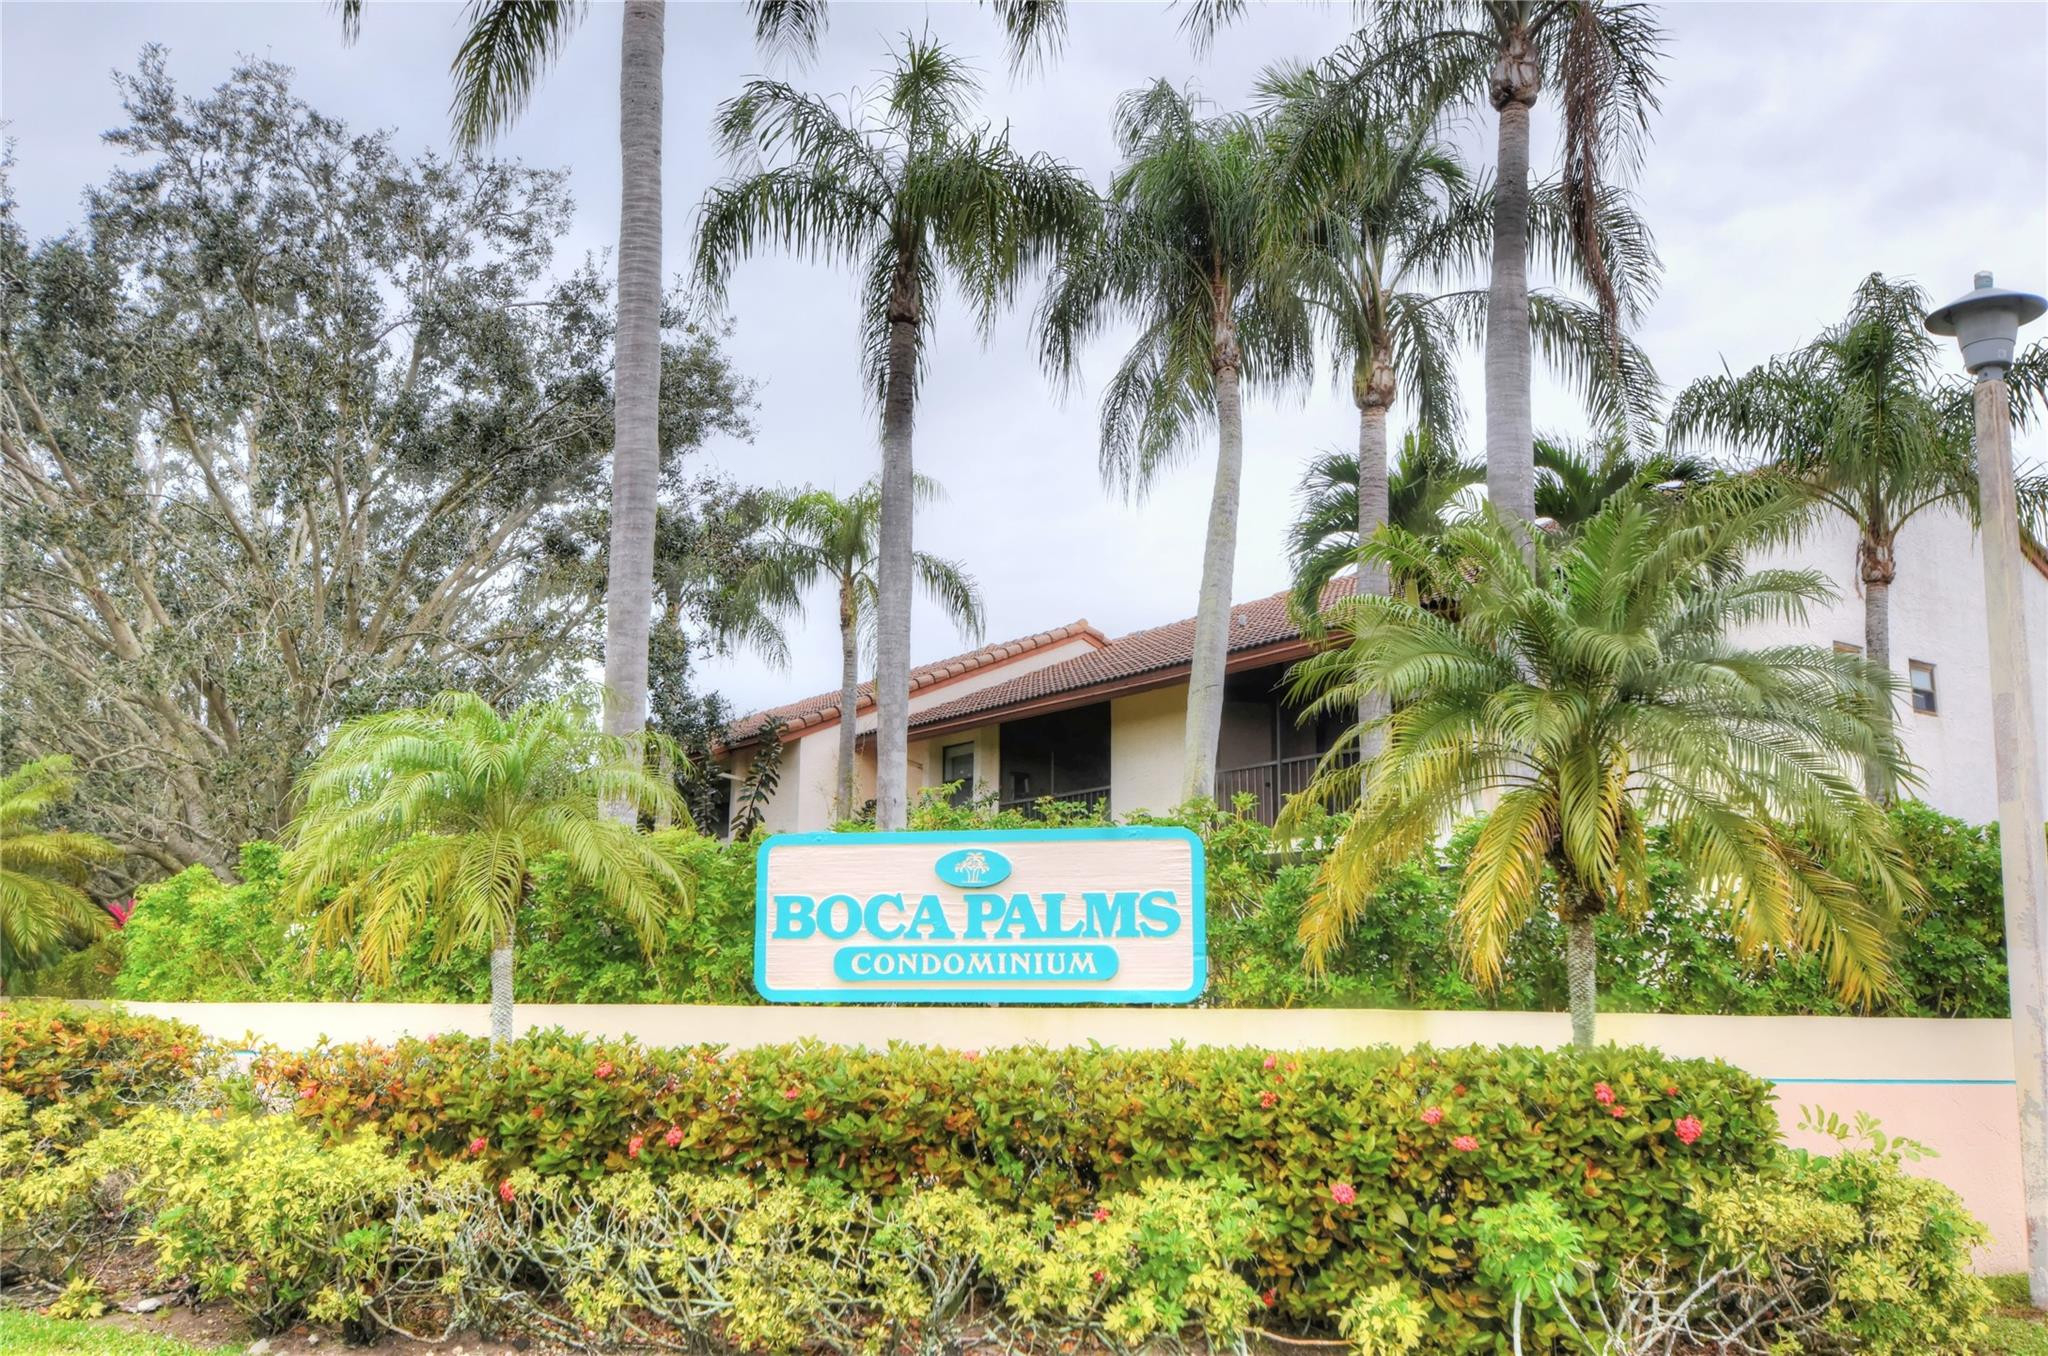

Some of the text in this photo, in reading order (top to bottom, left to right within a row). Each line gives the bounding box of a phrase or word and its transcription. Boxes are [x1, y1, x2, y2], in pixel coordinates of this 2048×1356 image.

[772, 891, 1182, 940] BOCA PALMS
[851, 952, 1098, 975] CONDOMINIUM
